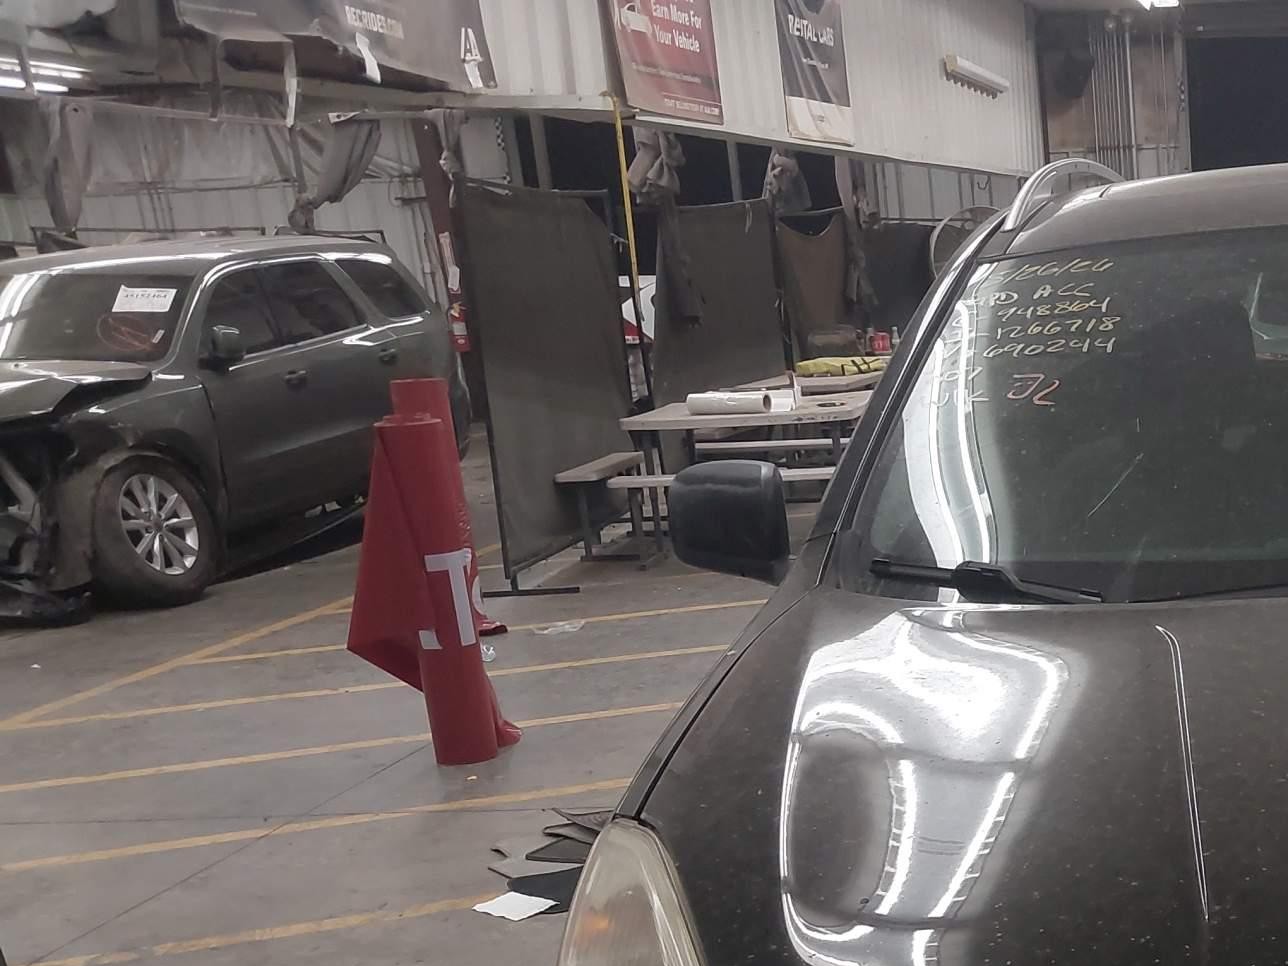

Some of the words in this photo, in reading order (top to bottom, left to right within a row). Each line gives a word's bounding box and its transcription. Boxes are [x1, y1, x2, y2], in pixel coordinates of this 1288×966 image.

[651, 3, 670, 20] Earn
[670, 3, 690, 26] More
[689, 10, 702, 29] For
[653, 23, 672, 46] Your
[672, 28, 700, 53] Vehicle
[996, 315, 1121, 341] 1266718
